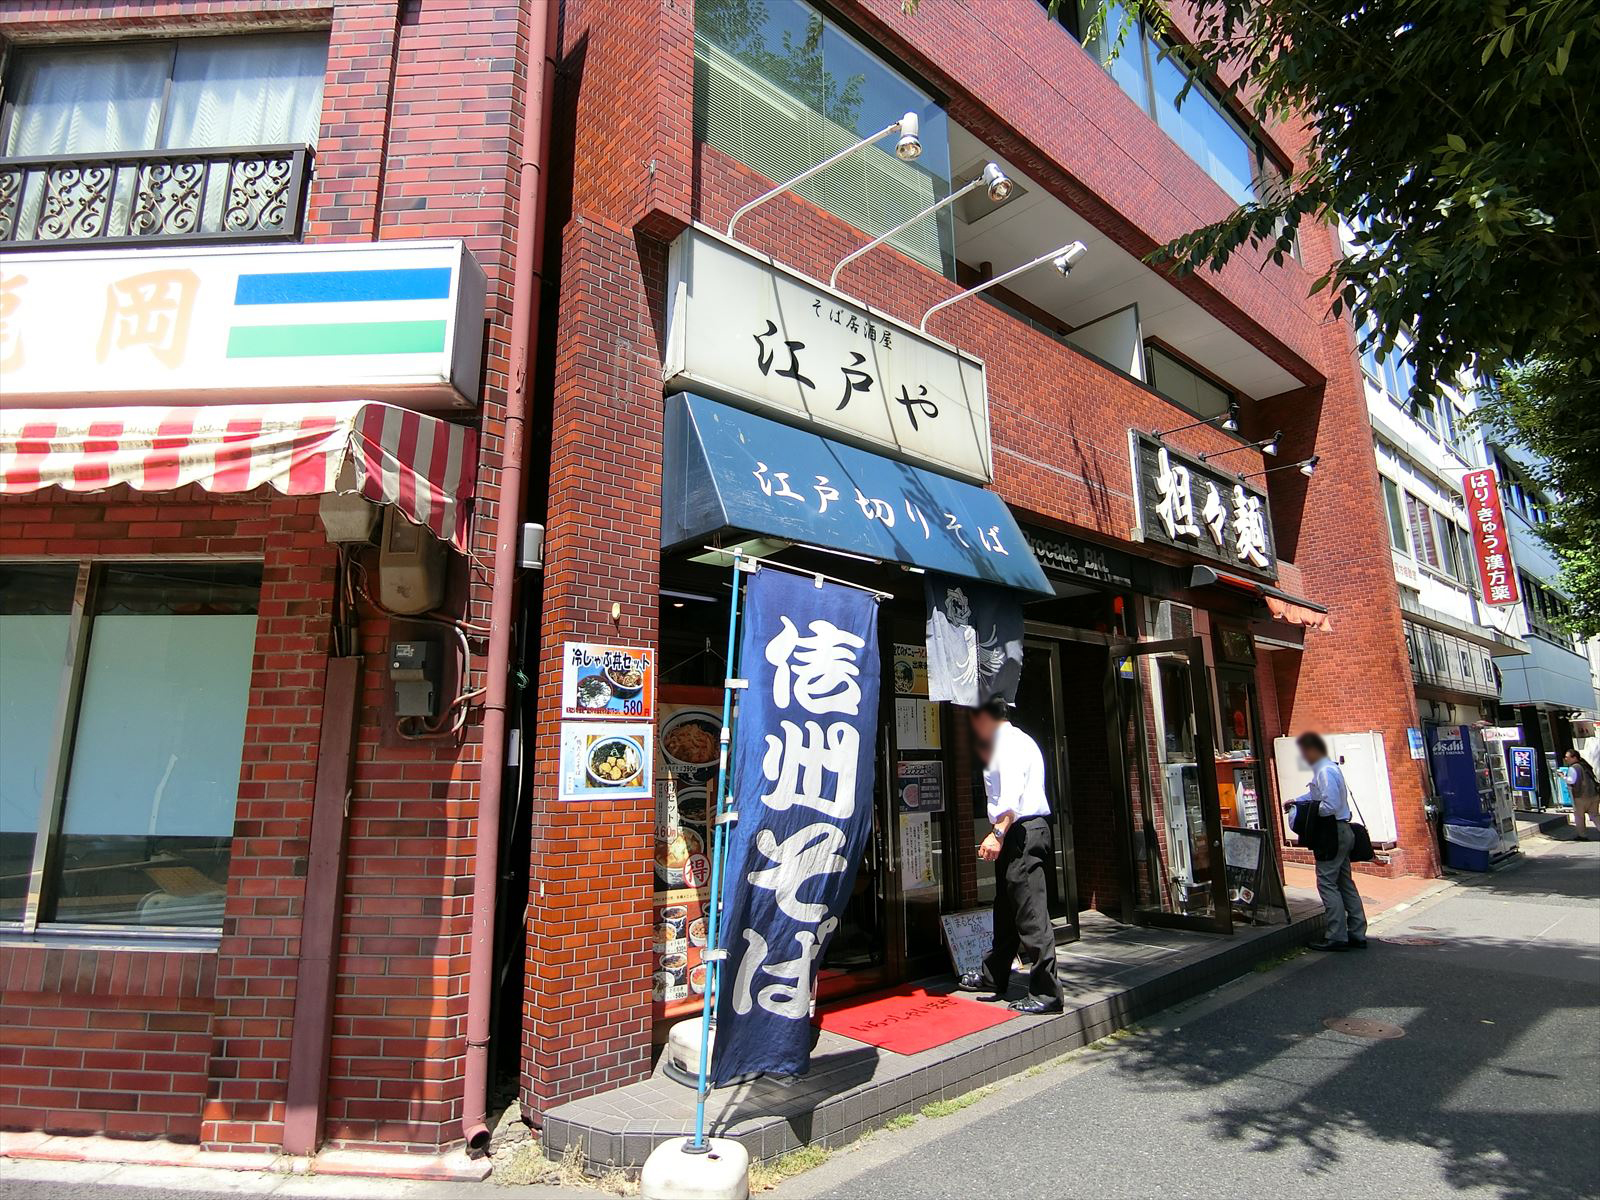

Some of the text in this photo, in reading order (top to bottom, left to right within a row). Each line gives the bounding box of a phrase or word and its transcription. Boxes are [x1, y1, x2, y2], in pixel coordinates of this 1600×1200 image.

[812, 298, 893, 350] そば居酒屋
[752, 319, 939, 431] 江戸や
[752, 461, 1009, 556] 江戸切りそば
[1470, 473, 1511, 600] はり・きゅう・漢方薬
[571, 648, 650, 671] 冷しゃぶ丼セット
[1432, 740, 1464, 752] Asahi
[733, 615, 865, 1019] 信州そば
[687, 859, 708, 883] 得
